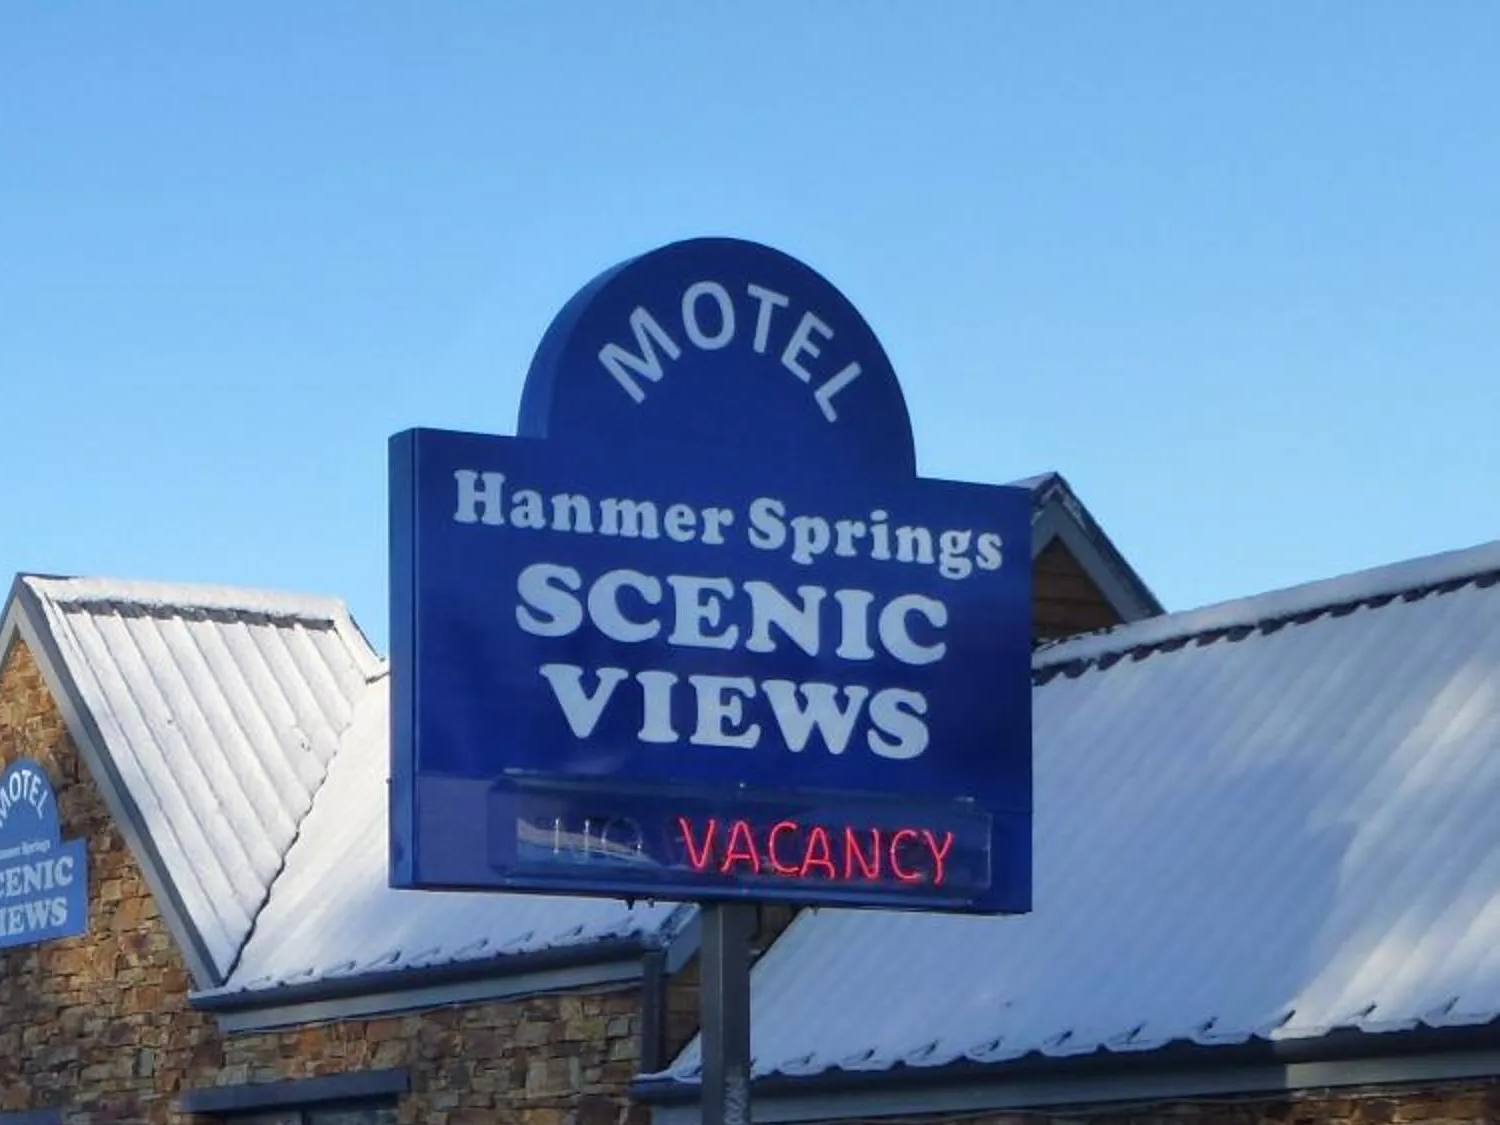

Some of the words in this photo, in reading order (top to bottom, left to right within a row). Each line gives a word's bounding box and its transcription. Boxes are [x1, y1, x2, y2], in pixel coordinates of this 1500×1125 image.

[599, 281, 862, 423] MOTEL
[453, 469, 735, 545] Hanmer
[748, 497, 1003, 580] Springs
[516, 563, 948, 664] SCENIC
[539, 664, 929, 759] VIEWS
[677, 816, 954, 886] VACANCY
